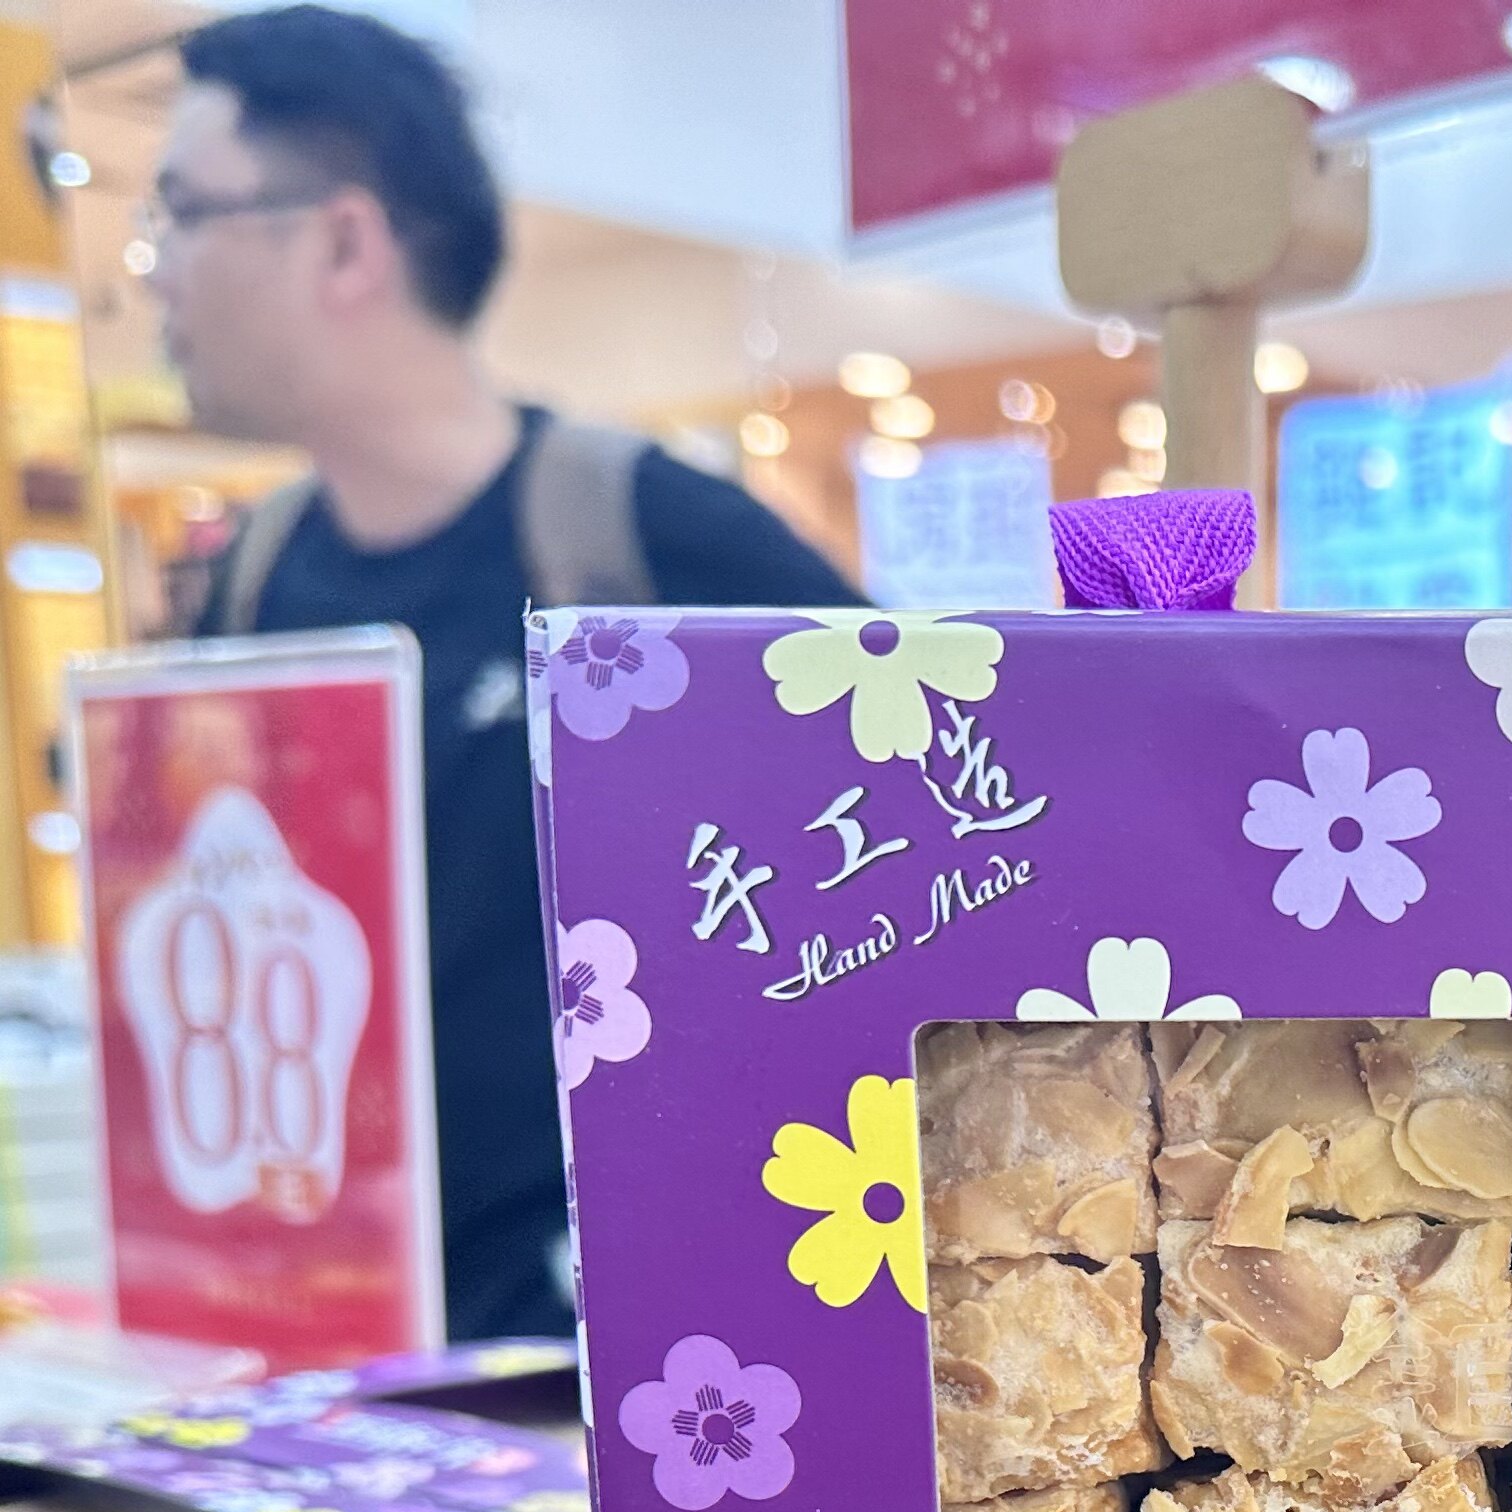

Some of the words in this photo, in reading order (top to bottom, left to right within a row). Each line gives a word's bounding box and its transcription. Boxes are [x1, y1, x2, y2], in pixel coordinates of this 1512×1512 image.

[687, 700, 1047, 953] 手工造
[762, 914, 897, 1001] Hand
[914, 856, 1032, 945] Made
